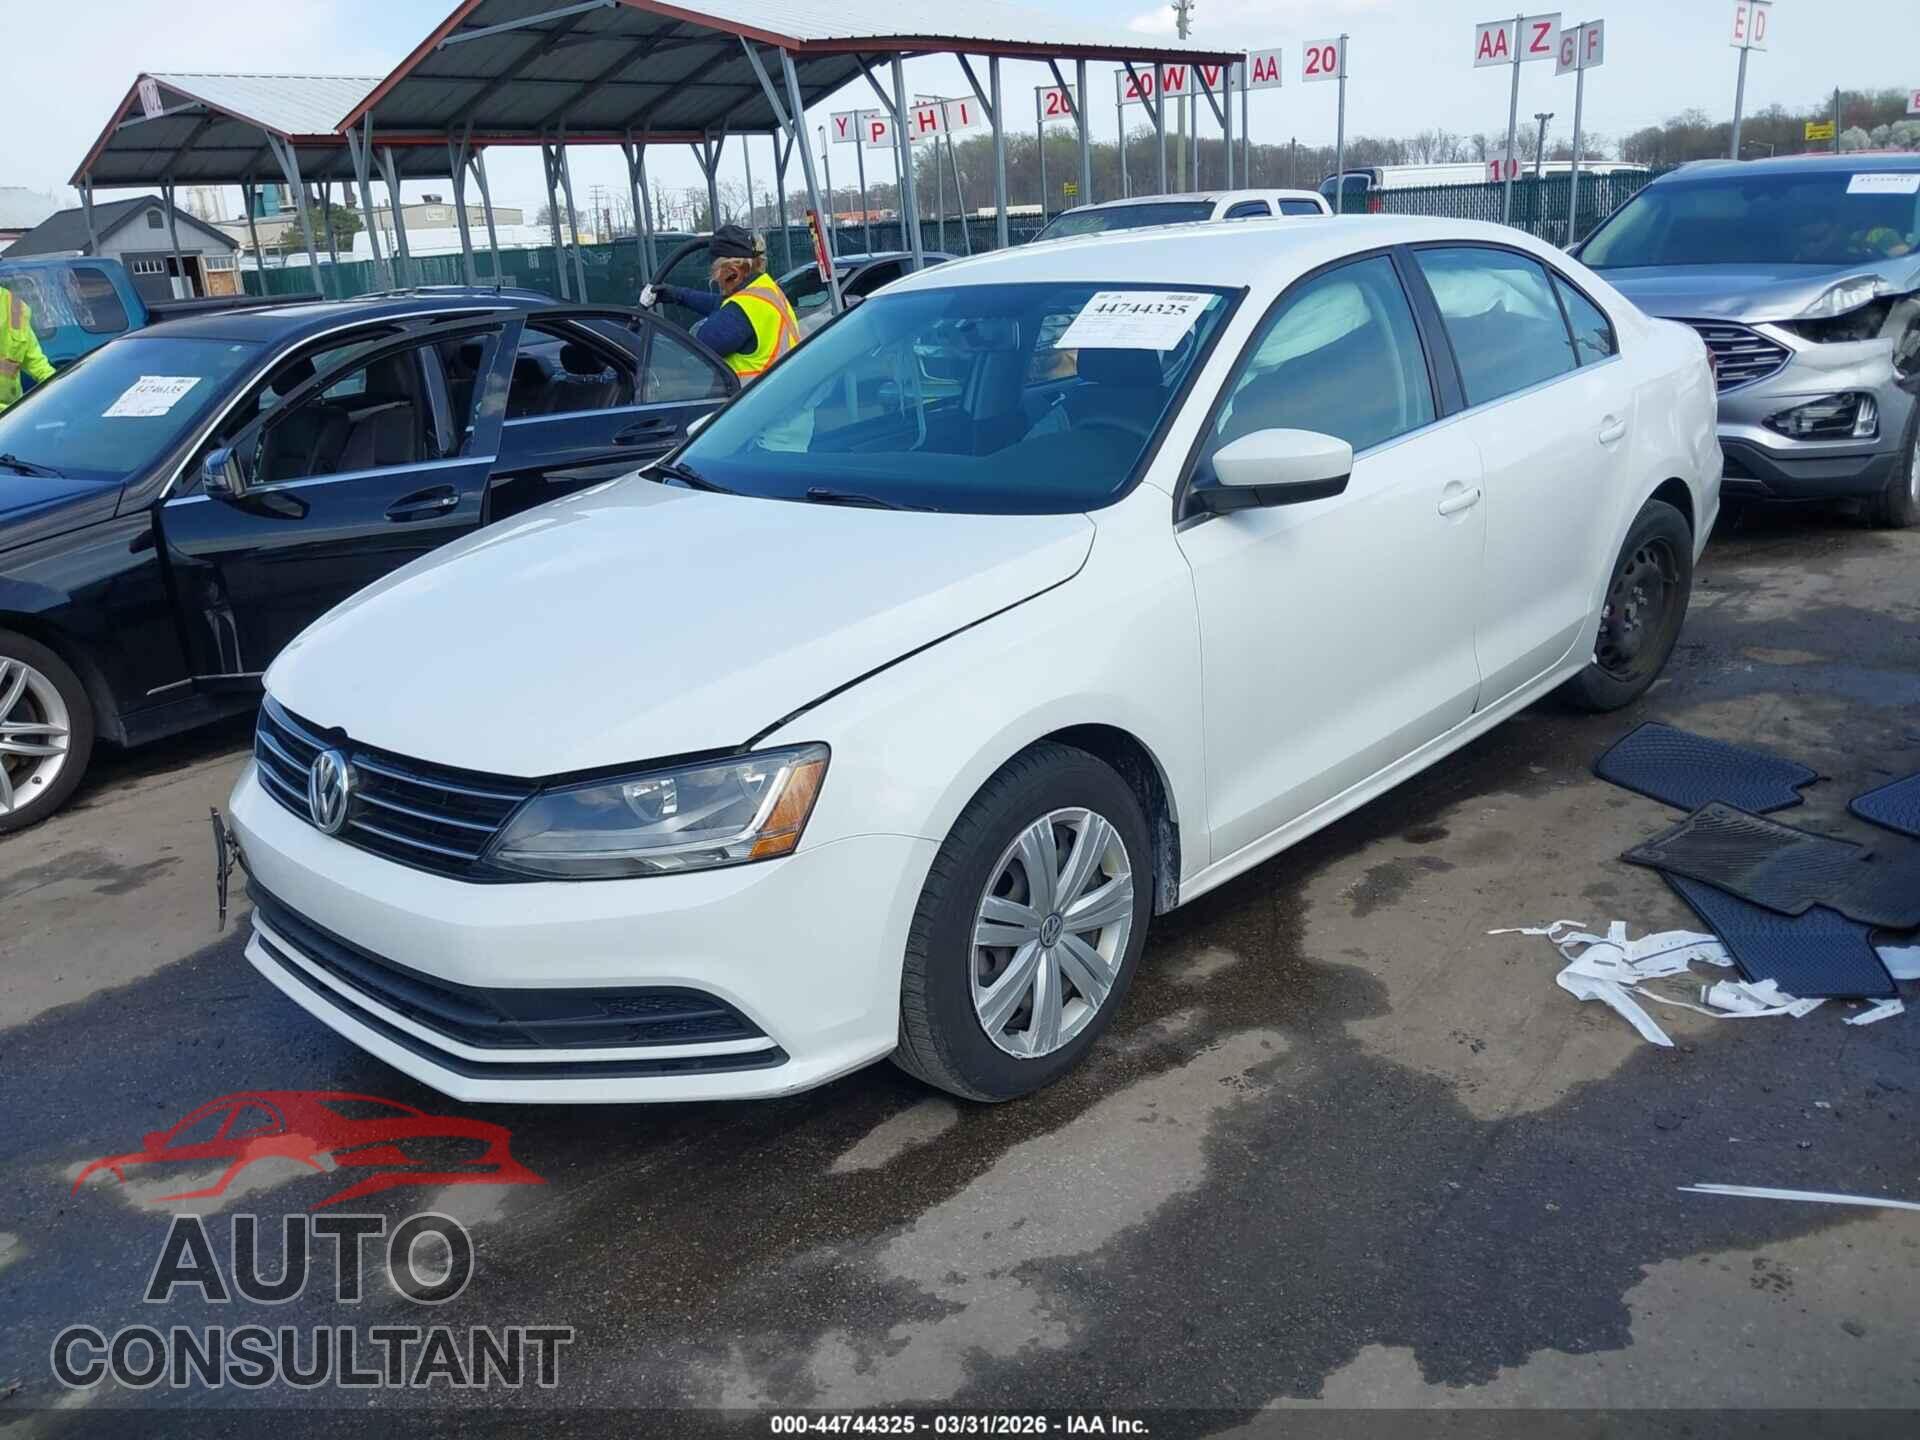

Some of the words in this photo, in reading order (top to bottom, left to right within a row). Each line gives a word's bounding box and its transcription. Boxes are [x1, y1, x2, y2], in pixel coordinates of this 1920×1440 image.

[1735, 6, 1746, 39] E
[1755, 9, 1766, 41] D
[1478, 28, 1508, 59] AA
[1529, 22, 1552, 52] Z
[1587, 29, 1599, 60] F
[1305, 46, 1337, 74] 20
[1560, 37, 1574, 66] G
[1162, 66, 1185, 92] W
[1202, 64, 1220, 86] V
[1252, 56, 1279, 82] AA
[1126, 73, 1153, 97] 20
[836, 116, 848, 137] Y
[871, 122, 885, 142] P
[918, 109, 937, 132] H
[1489, 158, 1517, 180] 10
[1094, 303, 1189, 315] 44744325
